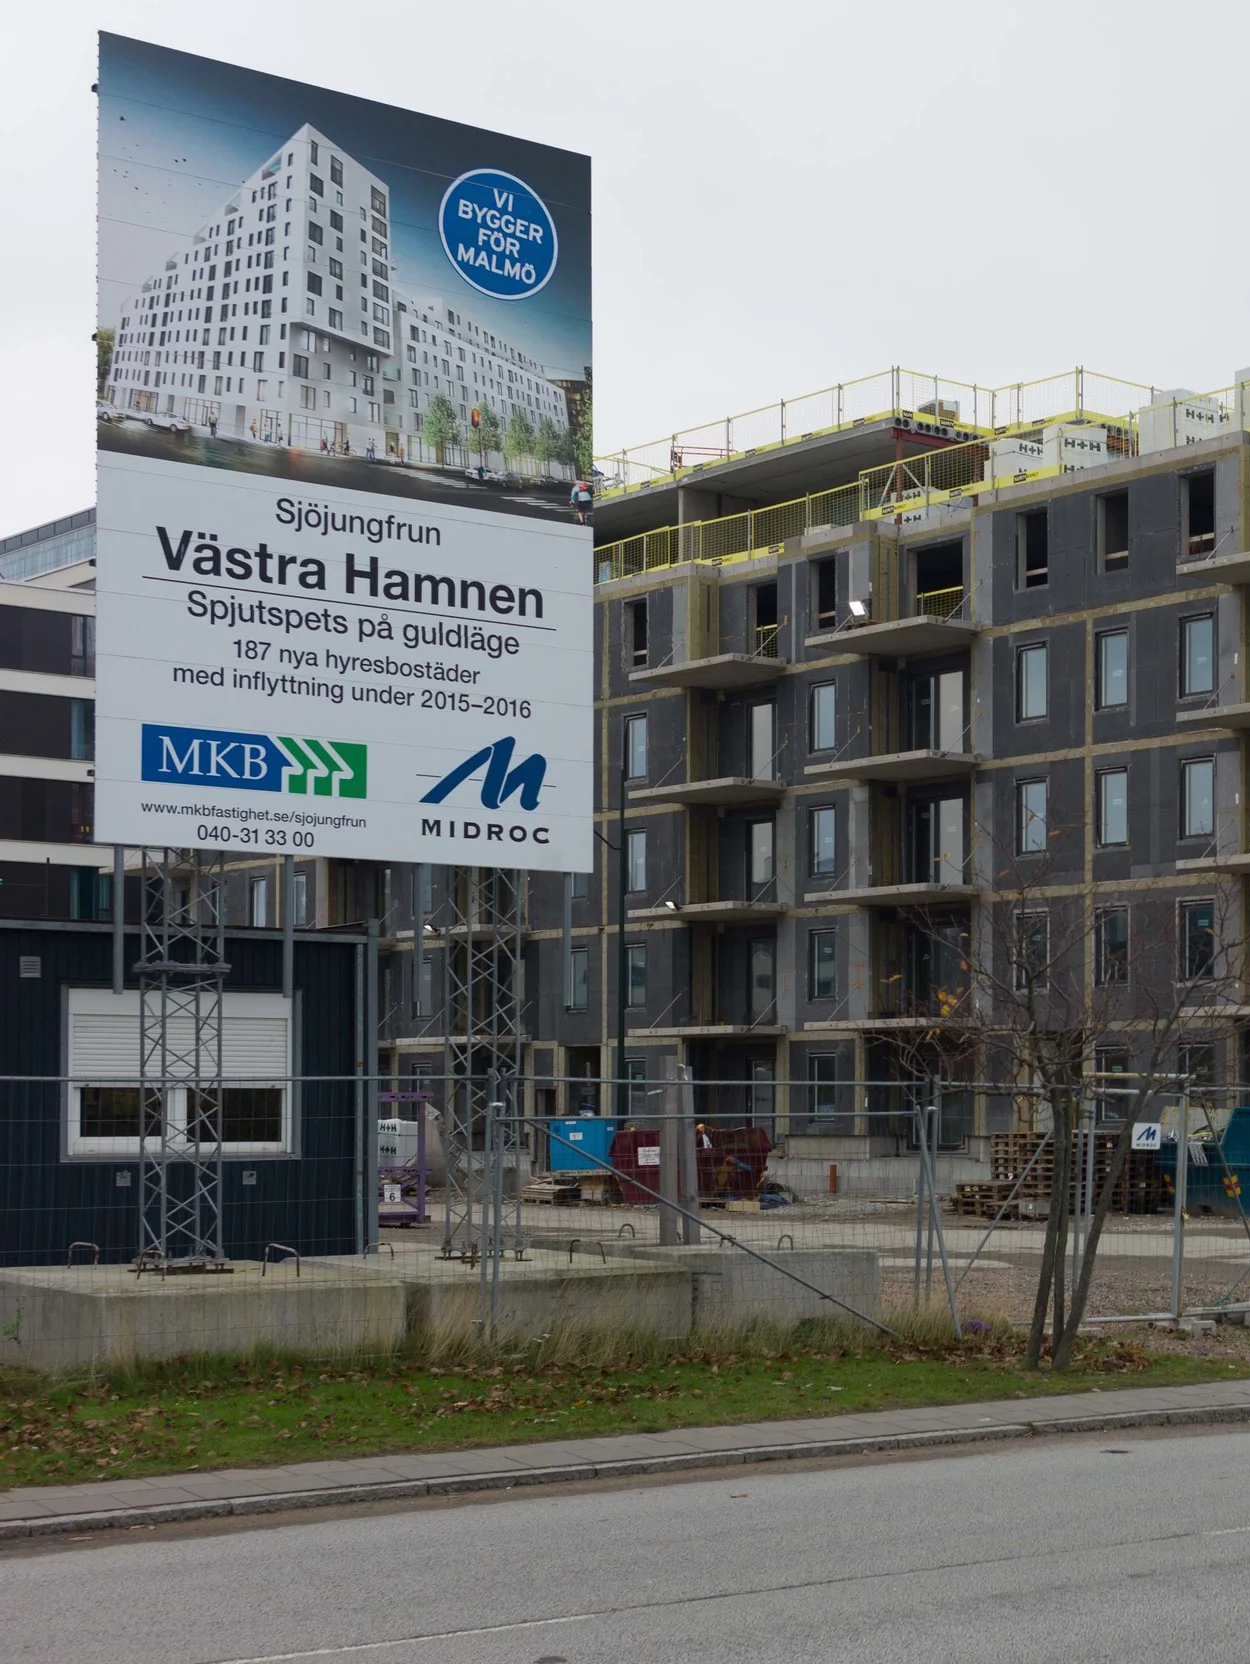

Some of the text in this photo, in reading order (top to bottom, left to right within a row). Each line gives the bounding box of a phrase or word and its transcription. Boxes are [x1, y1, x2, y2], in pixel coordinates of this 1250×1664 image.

[493, 188, 514, 212] VI
[458, 199, 544, 244] BYGGER
[457, 243, 536, 284] MALMÖ
[478, 228, 520, 258] FÖR
[275, 497, 441, 546] Sjöjungfrun
[156, 526, 544, 619] Västra Hamnen
[187, 590, 521, 658] Spjutspets på guldläge
[233, 639, 480, 685] 187 nya hyresbostäder
[173, 666, 225, 687] med
[233, 672, 344, 703] inflyttning
[351, 685, 414, 707] under
[157, 735, 269, 781] MKB
[141, 803, 367, 829] www.mkbfastighet.se/sjojungfrun
[196, 825, 314, 848] 040-31 33 00
[421, 818, 550, 845] MIDROC
[389, 1192, 396, 1201] 6
